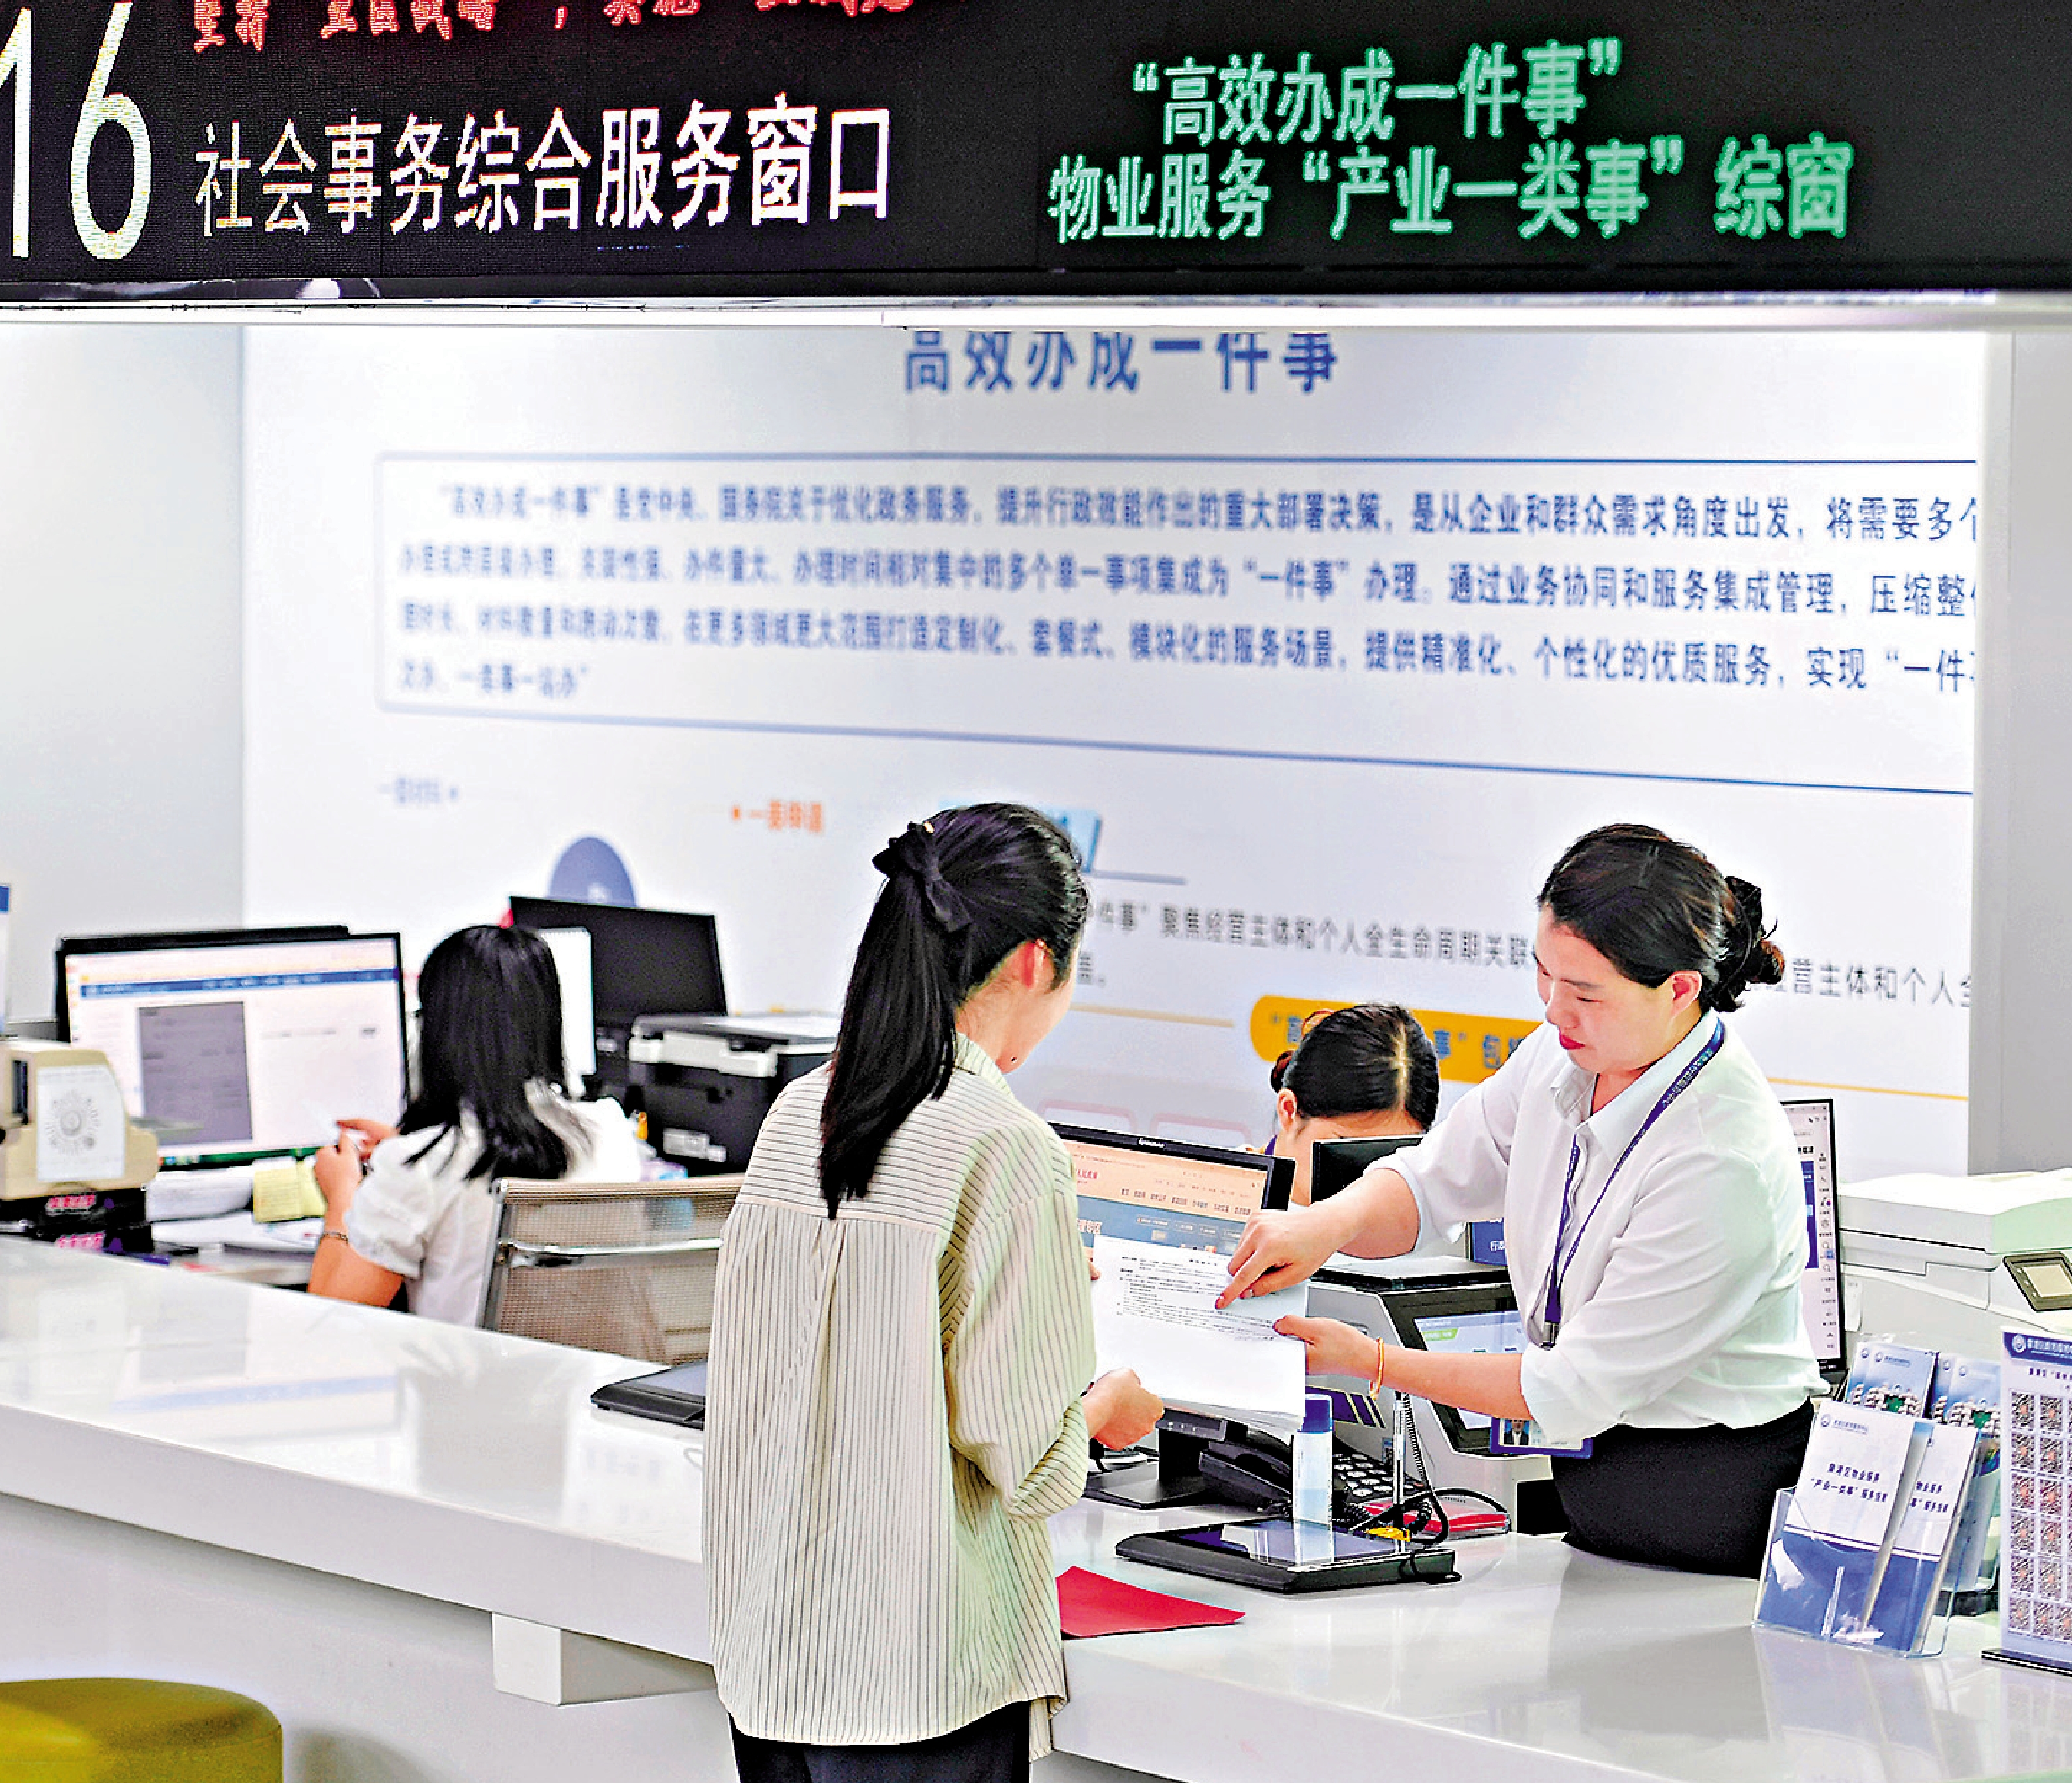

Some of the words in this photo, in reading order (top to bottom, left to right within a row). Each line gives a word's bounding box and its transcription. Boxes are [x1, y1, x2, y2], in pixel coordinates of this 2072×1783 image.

[1133, 38, 1622, 145] “高效办成一件事”
[195, 92, 890, 237] 社会事务综合服务窗口
[1047, 133, 1854, 243] 物业服务“产业一类事”综窗
[905, 331, 1336, 391] 高效办成一件事
[1776, 958, 1971, 1008] 营主体和个人
